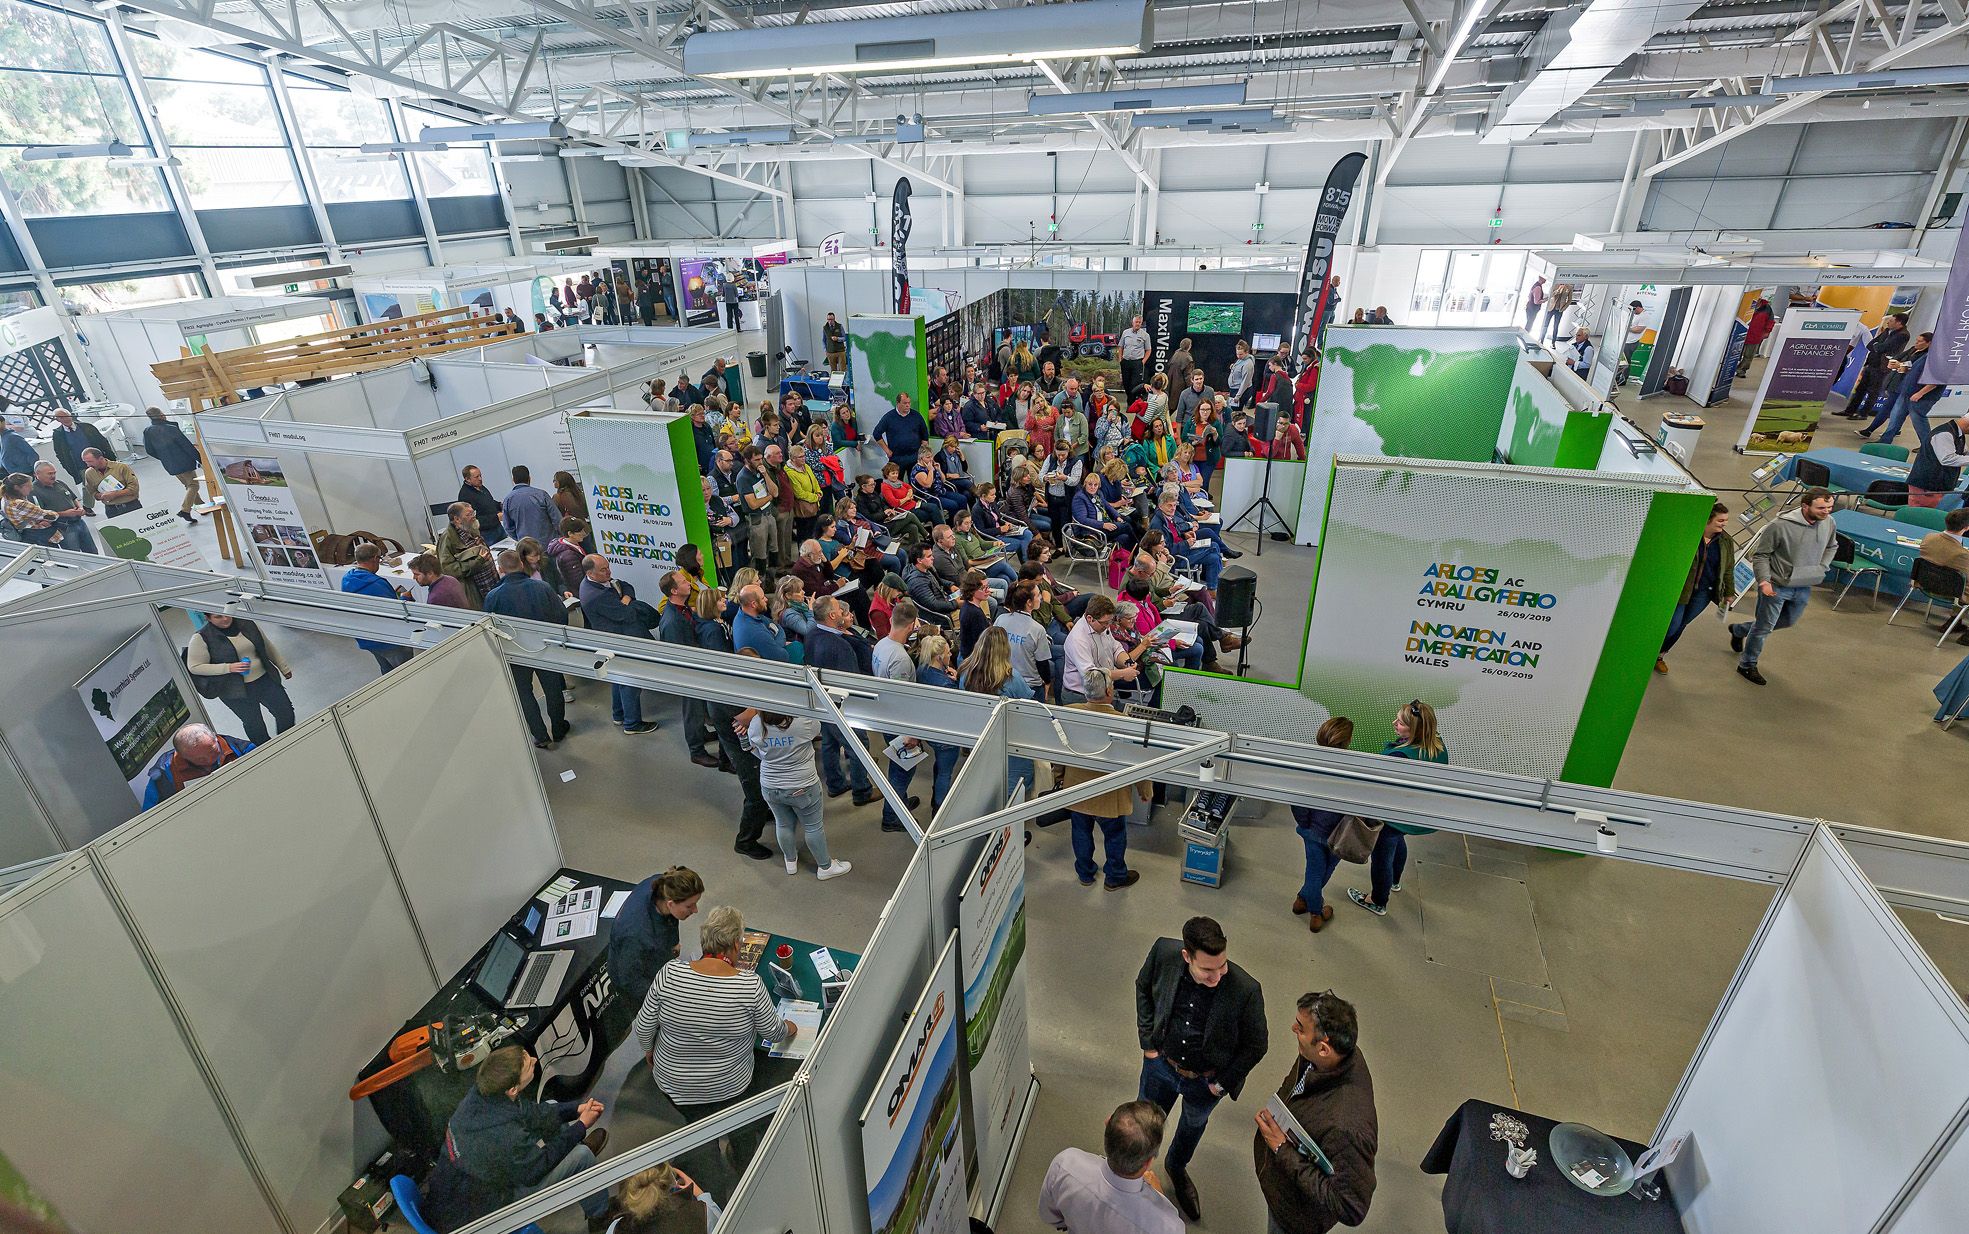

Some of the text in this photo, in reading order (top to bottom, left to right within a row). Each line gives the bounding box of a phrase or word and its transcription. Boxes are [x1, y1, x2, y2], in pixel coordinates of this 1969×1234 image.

[1154, 298, 1173, 374] MaxiVisio
[1789, 343, 1842, 351] AGRICULTURAL
[637, 493, 649, 501] AC
[597, 512, 673, 527] CYMRU 26/09/2019
[659, 541, 677, 549] AND
[606, 556, 633, 566] WALES
[1423, 562, 1525, 588] ARLOESI AC
[1417, 598, 1552, 623] CYMRU 26/09/2019
[1007, 632, 1027, 645] TAFF
[1511, 639, 1543, 651] AND
[1404, 654, 1534, 680] WALES 26/09/2019
[763, 736, 794, 748] STAFF
